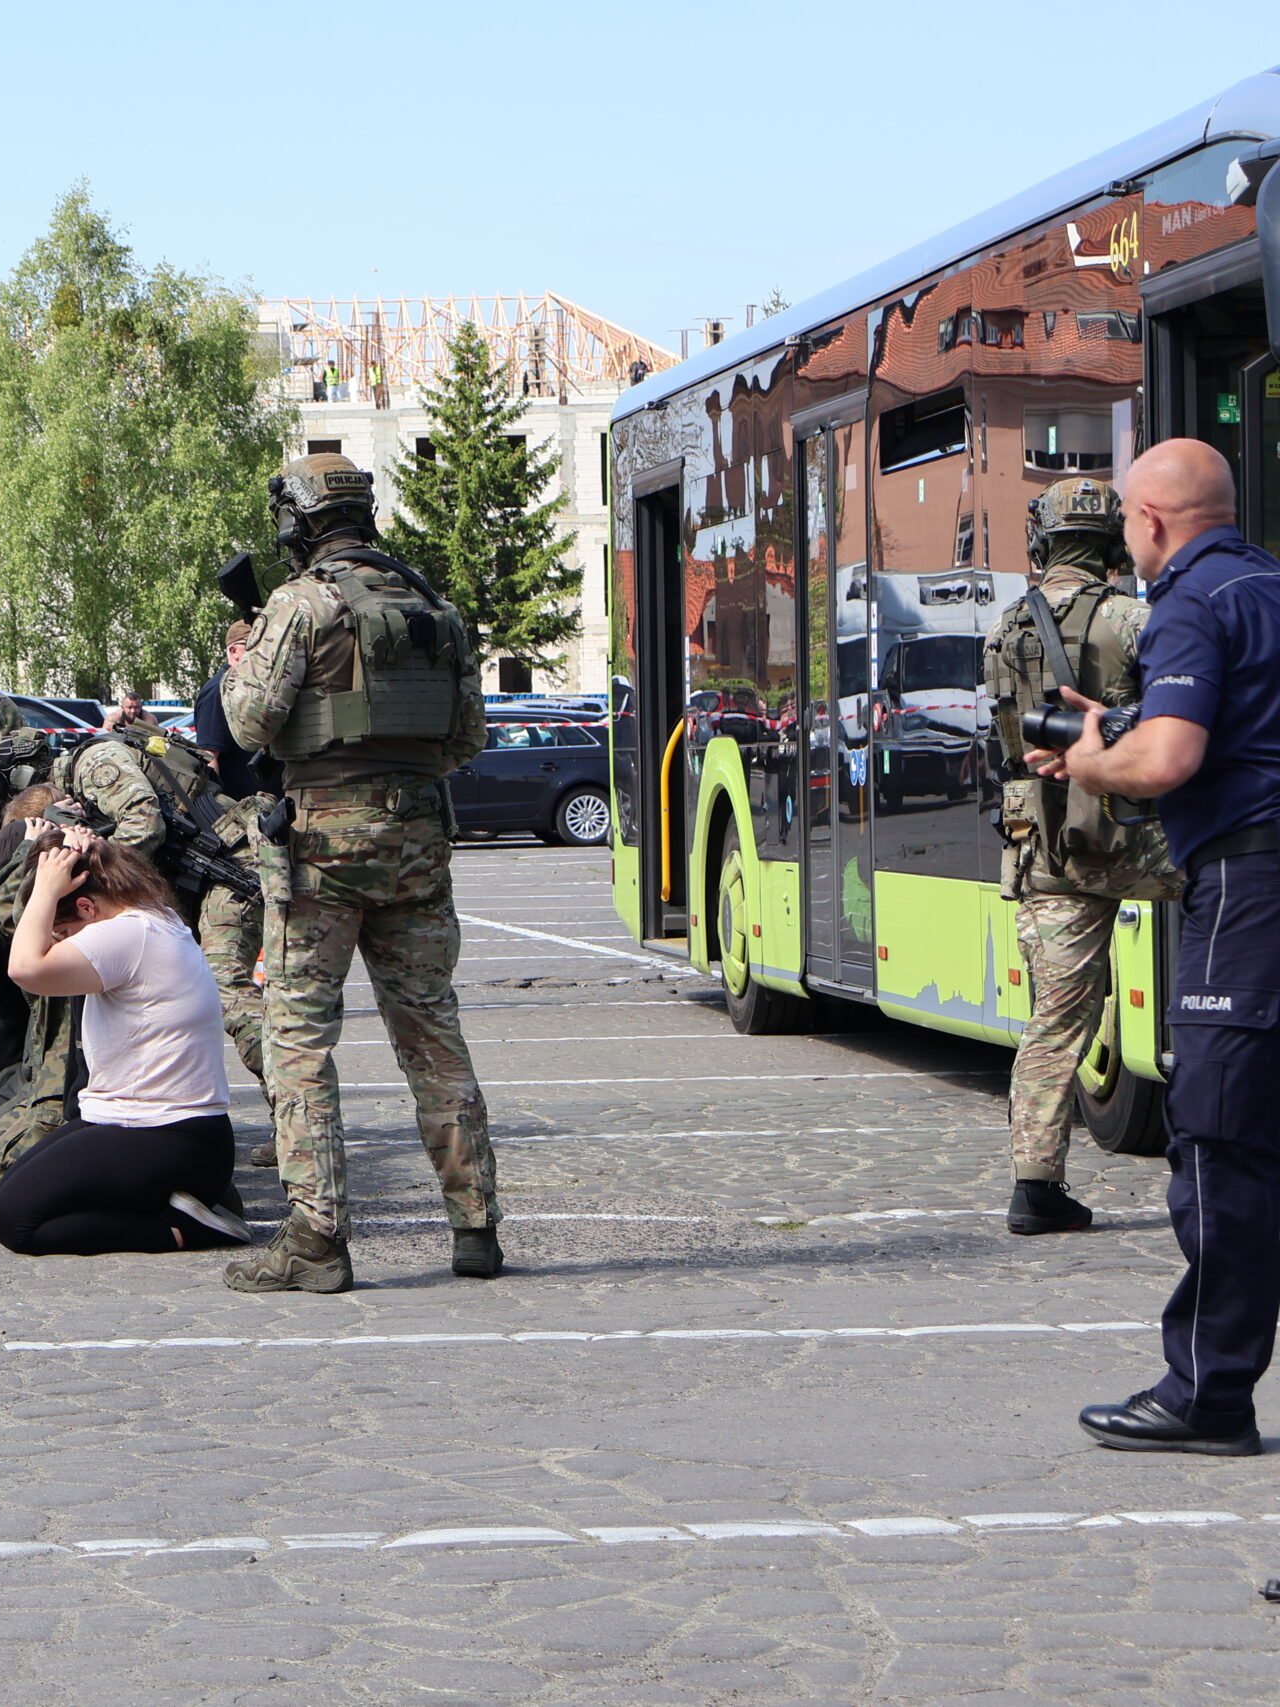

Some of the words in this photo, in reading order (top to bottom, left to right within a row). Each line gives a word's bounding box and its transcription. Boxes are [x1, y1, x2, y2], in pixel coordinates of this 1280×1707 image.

[1161, 205, 1192, 236] MAN
[1110, 211, 1139, 272] 664
[328, 475, 364, 485] POLICJA
[1071, 496, 1102, 513] K9
[1148, 675, 1195, 688] LICJA
[1181, 995, 1232, 1011] POLICJA
